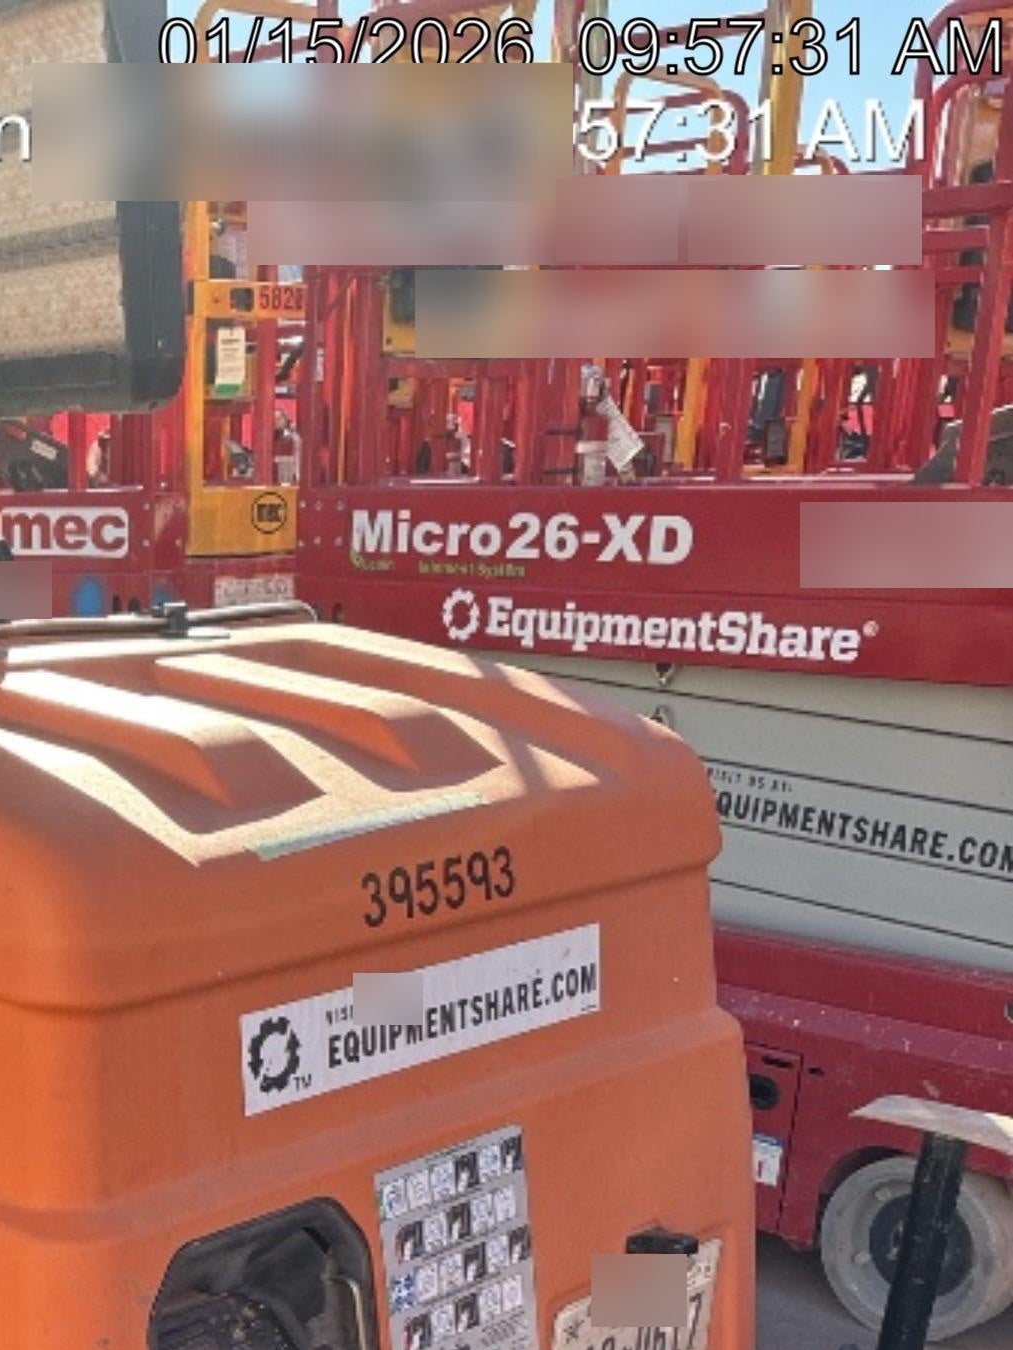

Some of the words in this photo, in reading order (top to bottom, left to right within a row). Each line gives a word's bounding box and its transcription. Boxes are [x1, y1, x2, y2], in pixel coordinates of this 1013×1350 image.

[2, 511, 127, 551] mec
[351, 509, 694, 565] Micro26-XD
[713, 789, 1013, 874] QUIPMENTSHARE.COM
[361, 846, 515, 928] 395593
[328, 962, 597, 1069] EQUIPMENTSHARE.COM
